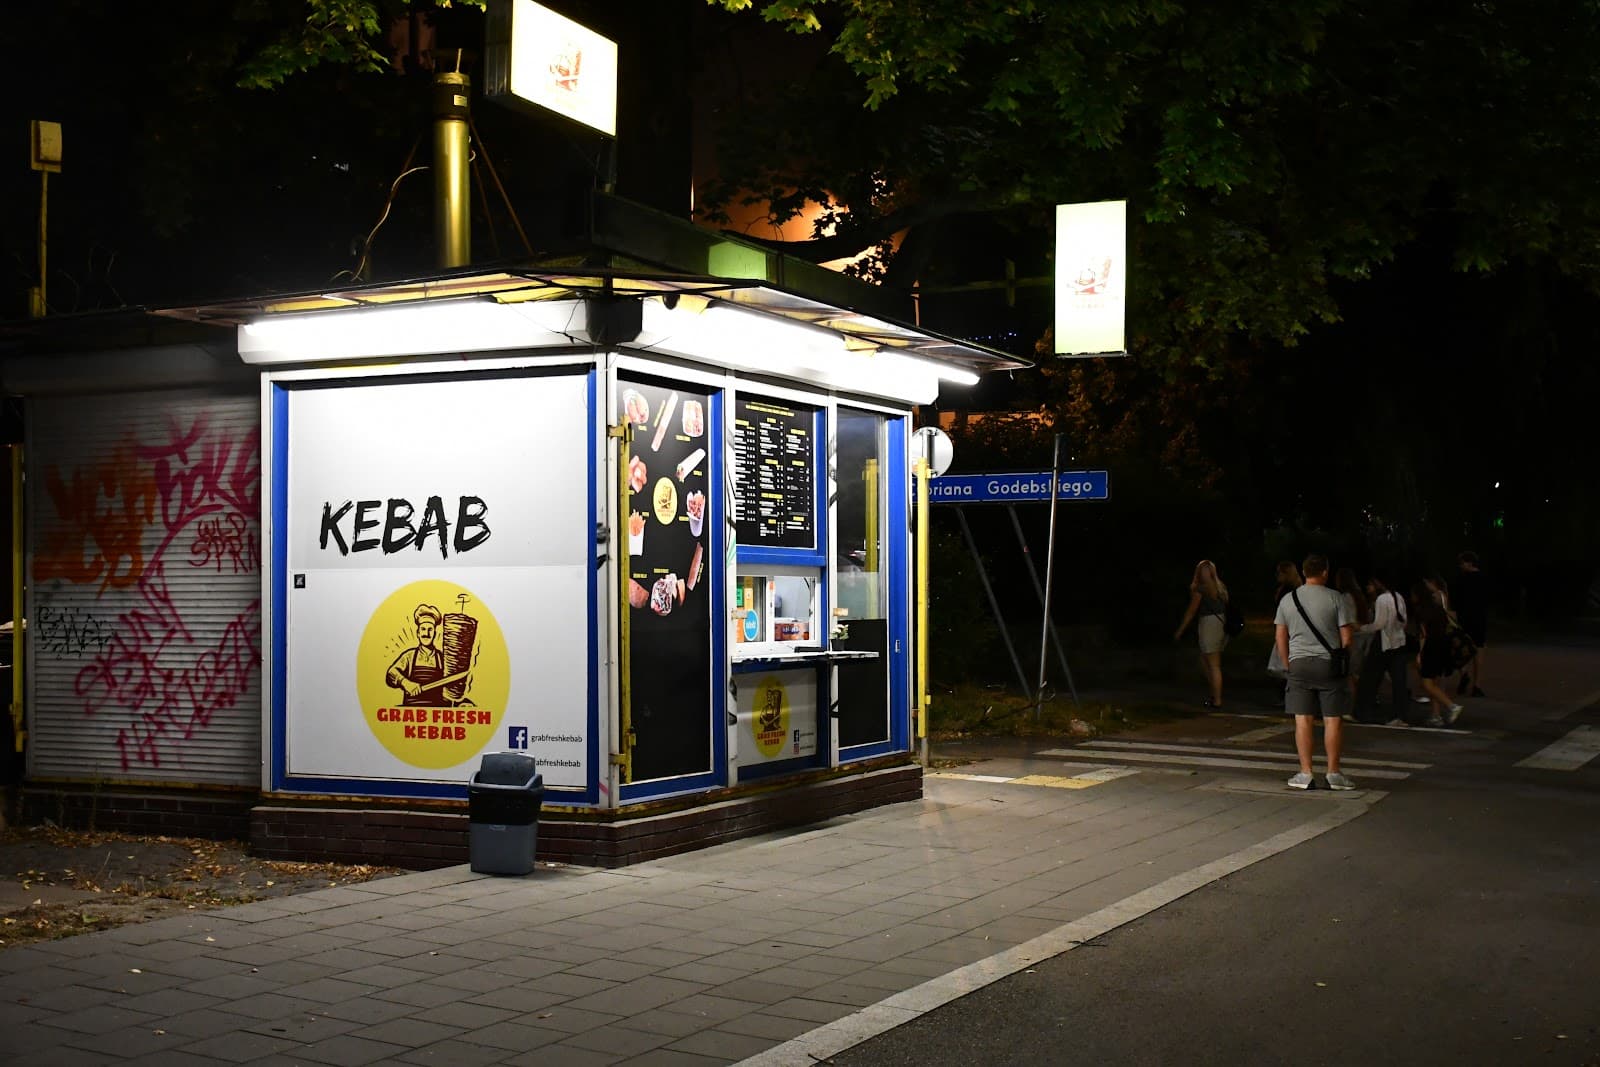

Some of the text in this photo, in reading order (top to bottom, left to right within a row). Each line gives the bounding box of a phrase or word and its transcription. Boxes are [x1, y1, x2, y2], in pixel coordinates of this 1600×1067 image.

[912, 482, 972, 497] riana
[319, 495, 491, 560] KEBAB
[376, 708, 491, 725] GRAB FRESH
[404, 725, 467, 741] KEBAB
[530, 733, 583, 744] grabfreshkebab
[535, 759, 582, 768] abfreshkebab
